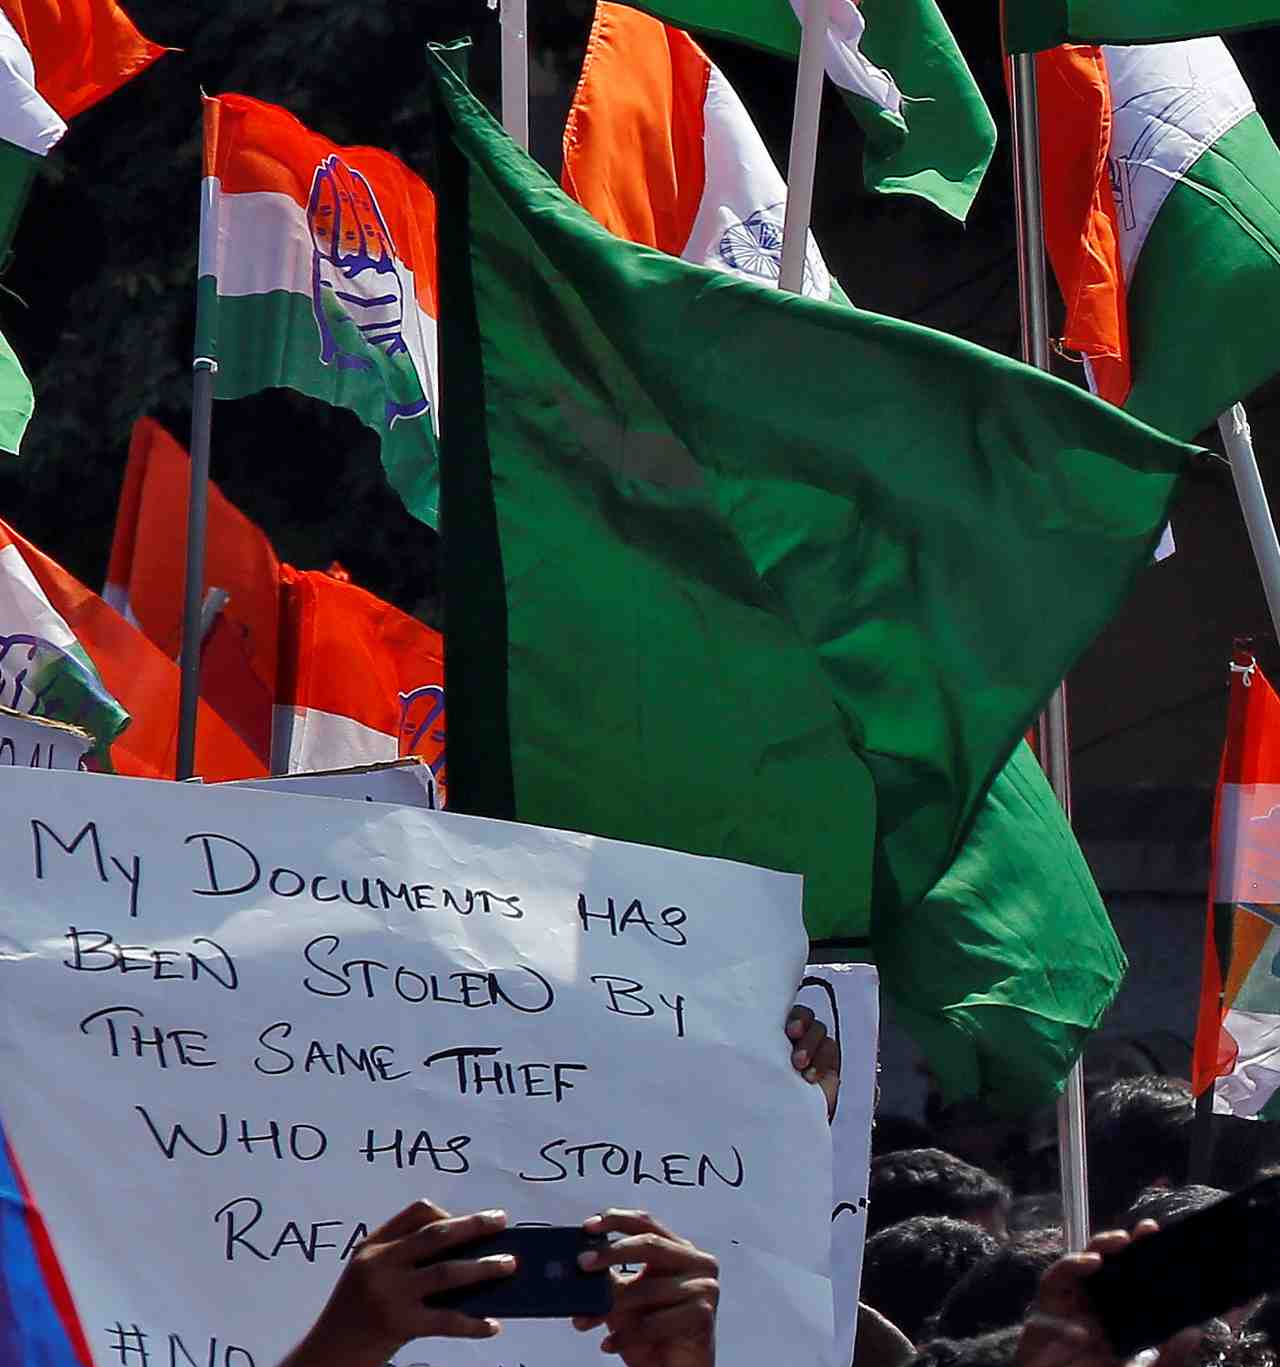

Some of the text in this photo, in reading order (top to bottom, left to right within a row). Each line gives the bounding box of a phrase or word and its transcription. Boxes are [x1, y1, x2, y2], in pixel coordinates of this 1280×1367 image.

[577, 893, 687, 946] HAS
[63, 926, 239, 990] BEEN
[303, 935, 554, 1013] STOLEN
[79, 1006, 588, 1103] THE SAME THIEF
[135, 1105, 744, 1188] WHO HAS STOLEN
[214, 1197, 369, 1263] RAFA
